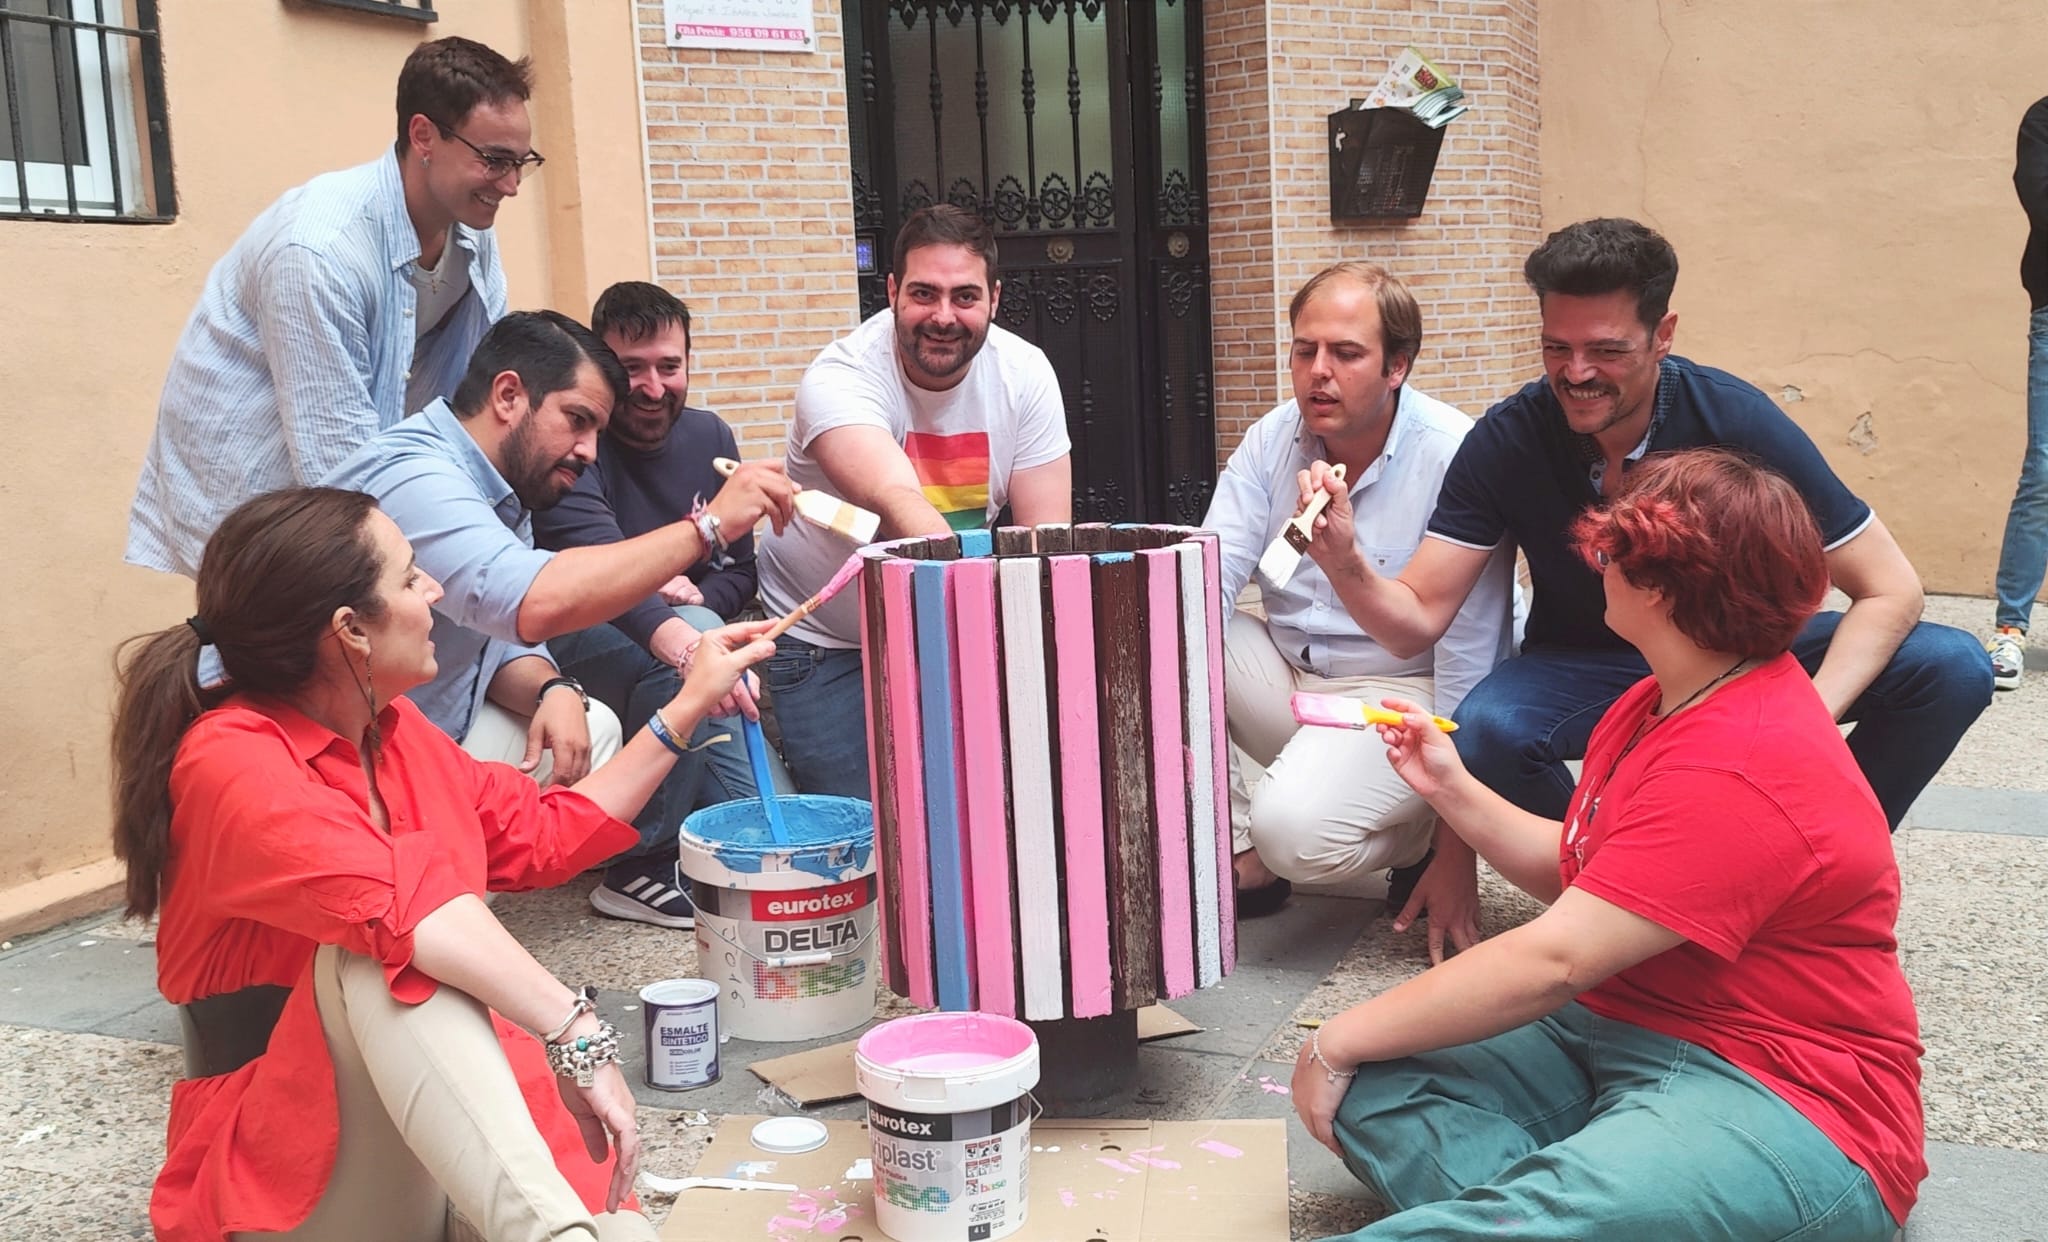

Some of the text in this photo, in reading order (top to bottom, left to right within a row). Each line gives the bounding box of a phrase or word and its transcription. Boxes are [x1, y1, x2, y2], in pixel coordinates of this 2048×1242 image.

[768, 892, 854, 915] eurotex
[764, 919, 860, 953] DELTA
[660, 1022, 709, 1036] ESMALTE
[870, 1109, 932, 1136] eurotex
